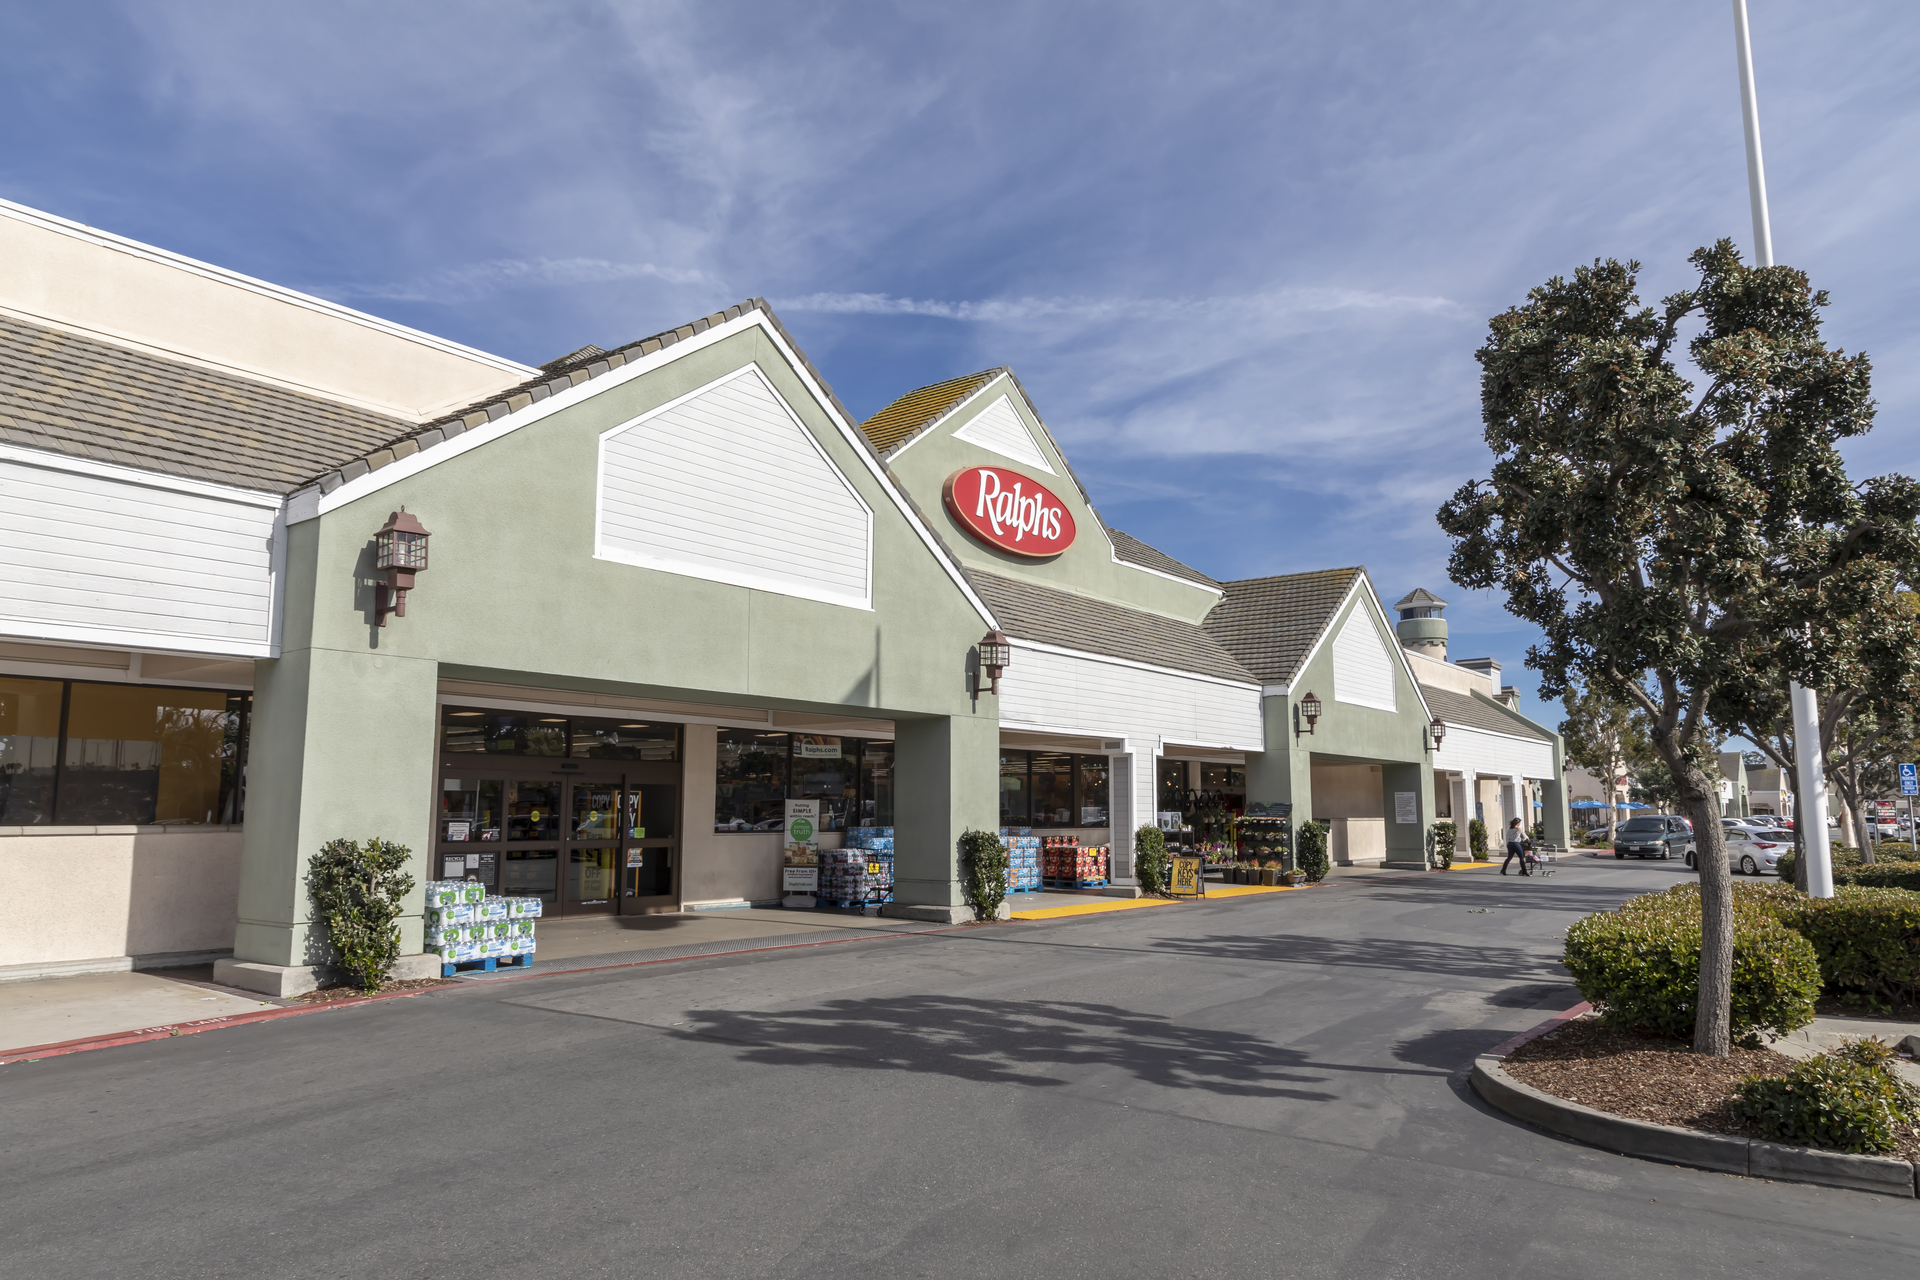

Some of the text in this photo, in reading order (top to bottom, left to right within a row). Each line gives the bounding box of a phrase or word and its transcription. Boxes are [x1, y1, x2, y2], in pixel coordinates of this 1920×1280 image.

[975, 469, 1062, 542] Ralphs
[1179, 861, 1194, 869] COPY
[585, 868, 602, 879] OFF
[1178, 868, 1194, 878] KEYS
[1177, 877, 1192, 886] HERE
